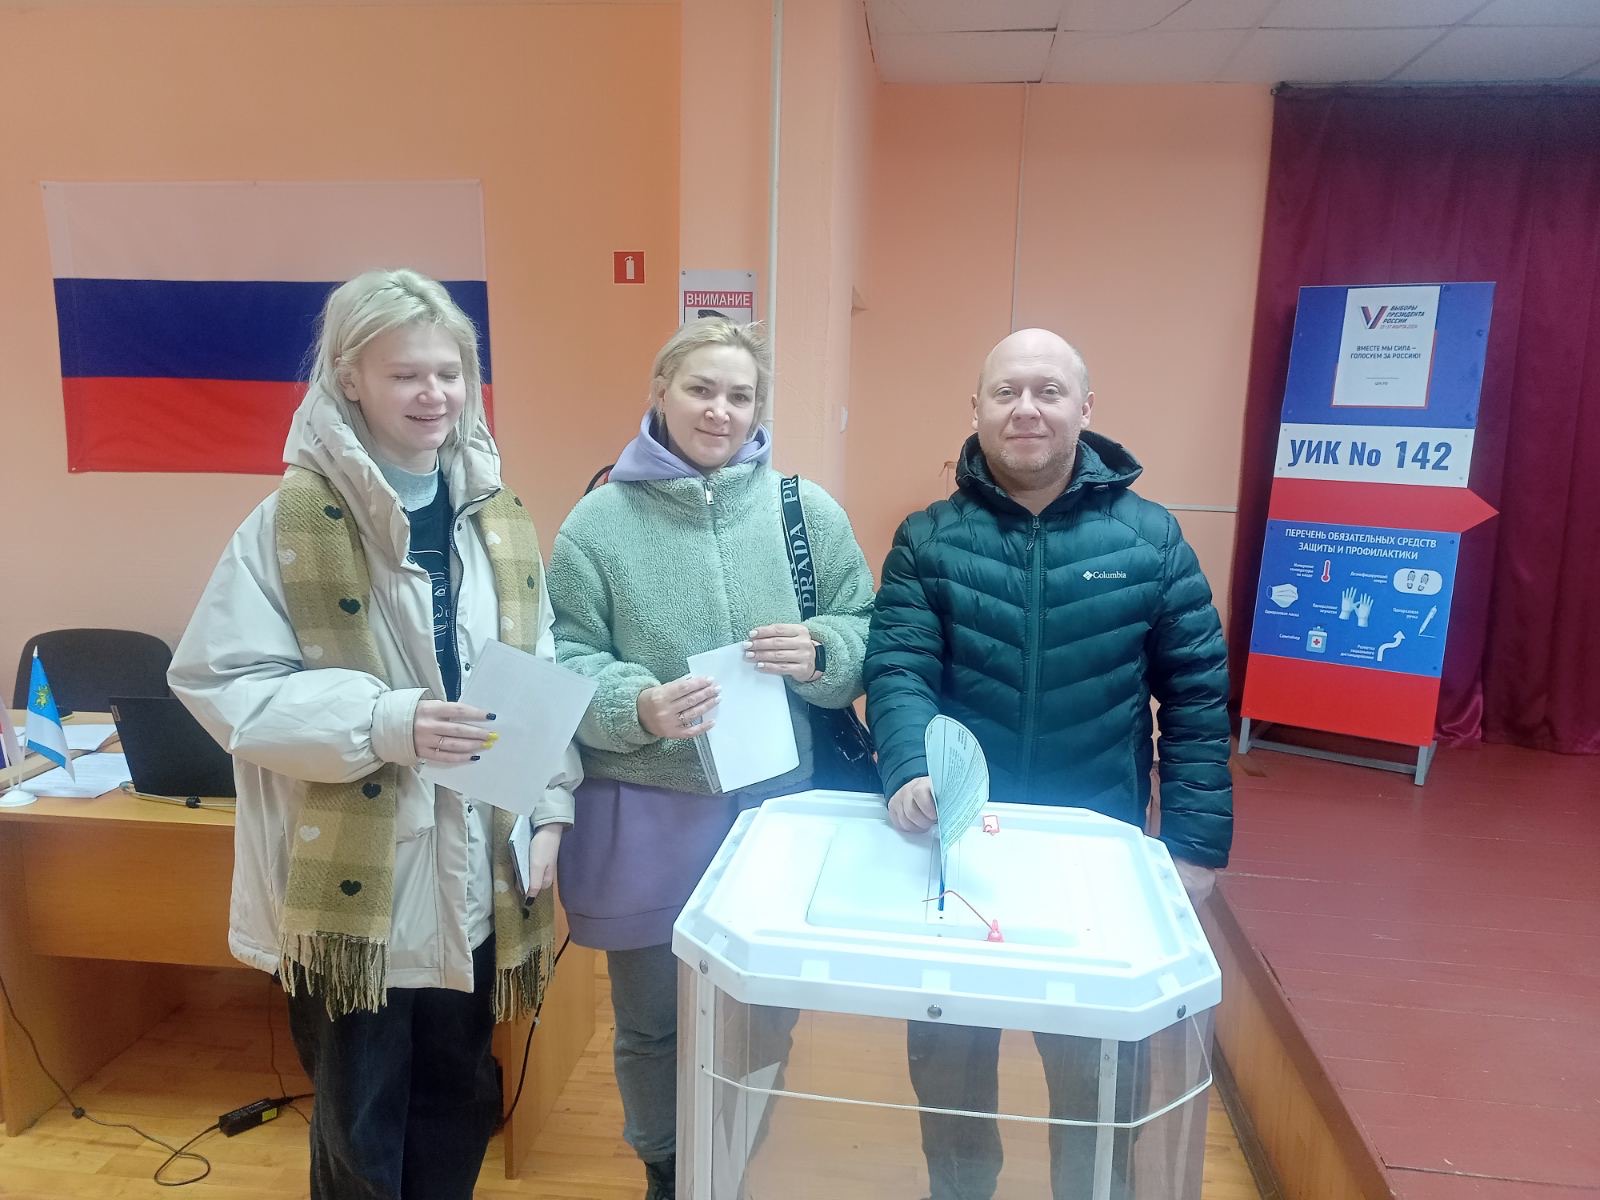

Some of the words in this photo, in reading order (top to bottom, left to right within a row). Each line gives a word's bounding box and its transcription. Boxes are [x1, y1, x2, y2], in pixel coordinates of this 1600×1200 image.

[686, 293, 750, 306] ВНИМАНИЕ
[1288, 440, 1341, 467] УИК
[1396, 441, 1453, 471] 142
[1285, 528, 1327, 540] ПЕРЕЧЕНЬ
[1328, 531, 1395, 545] ОБЯЗАТЕЛЬНЫХ
[1397, 537, 1437, 548] СРЕДСТВ
[1298, 542, 1336, 553] ЗАЩИТЫ
[1337, 546, 1344, 554] И
[1345, 546, 1419, 560] ПРОФИЛАКТИКИ
[789, 522, 815, 608] PRADA
[1092, 570, 1127, 579] Columbia
